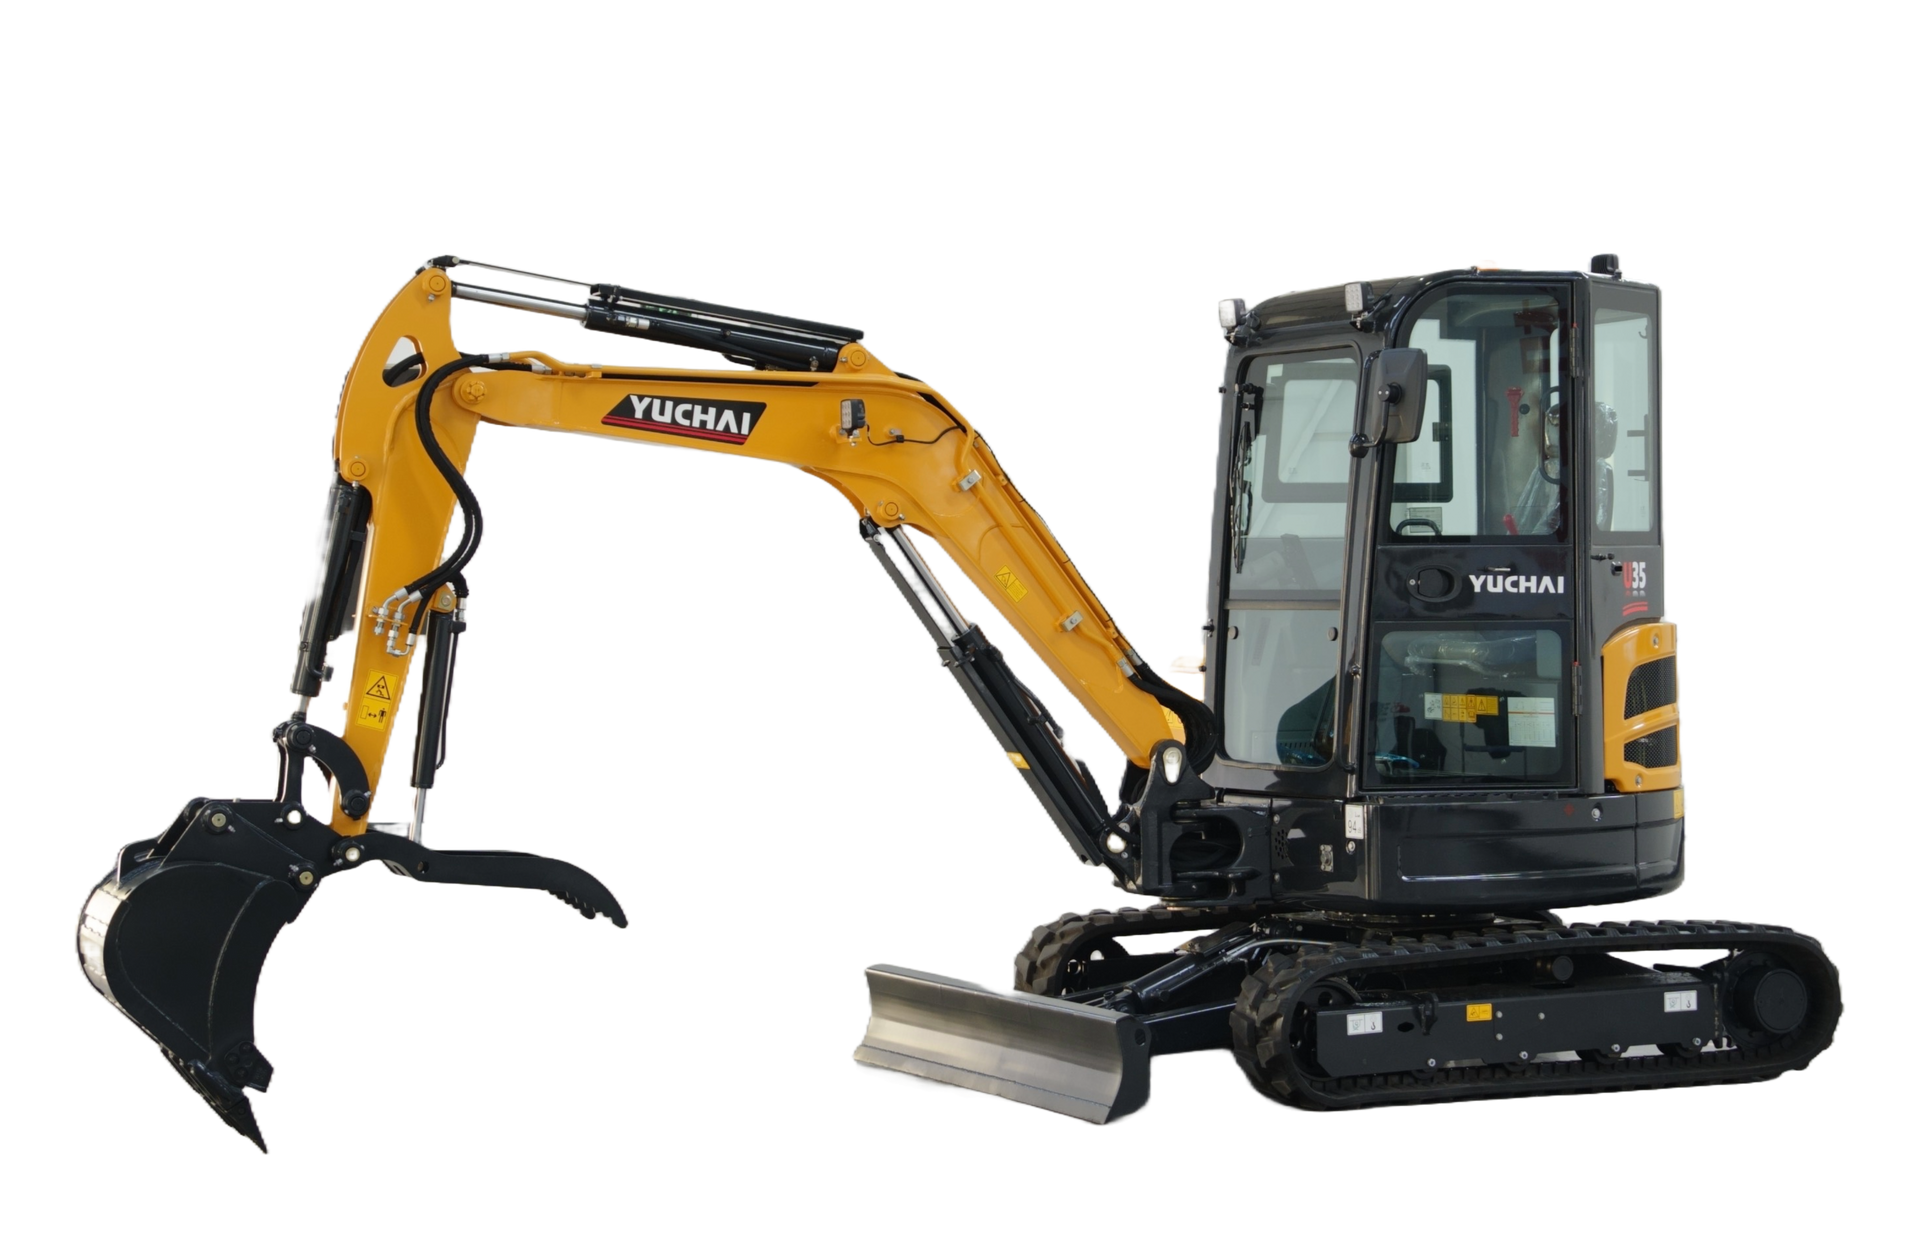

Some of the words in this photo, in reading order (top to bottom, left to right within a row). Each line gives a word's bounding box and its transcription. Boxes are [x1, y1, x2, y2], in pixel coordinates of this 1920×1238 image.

[629, 395, 751, 435] YUCHAI
[1469, 575, 1564, 594] YUCHAI
[1623, 561, 1646, 589] U35
[1348, 819, 1357, 834] 94
